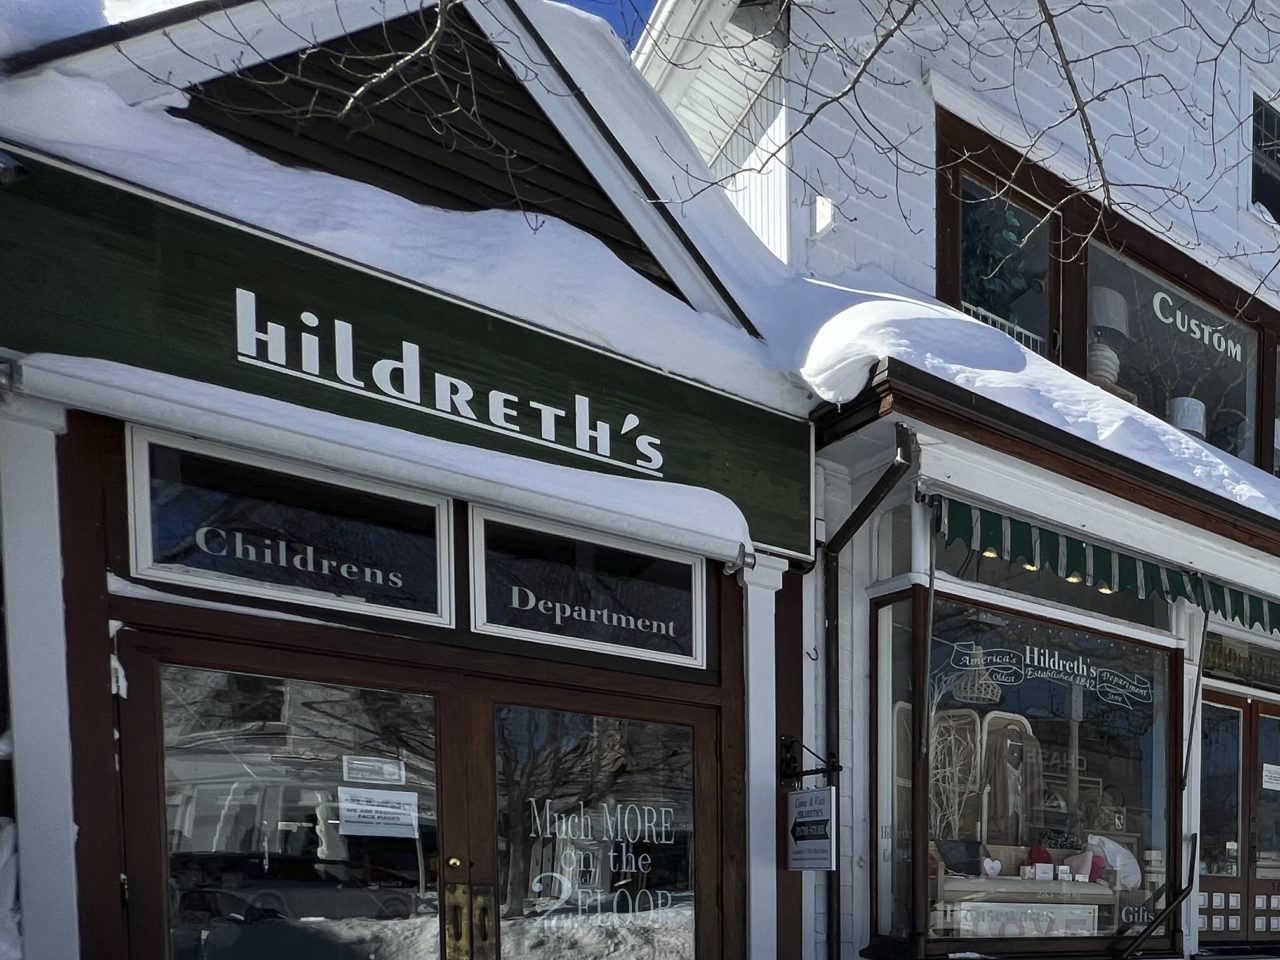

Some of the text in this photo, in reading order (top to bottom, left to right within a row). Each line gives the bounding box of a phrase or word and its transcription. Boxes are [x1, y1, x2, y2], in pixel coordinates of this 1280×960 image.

[195, 527, 677, 638] Childrens Department
[959, 654, 1017, 666] America's
[1024, 645, 1097, 678] Hildreth's
[992, 673, 1016, 683] Oldest
[1025, 667, 1095, 690] Established 1842
[1101, 671, 1147, 696] Department
[528, 798, 675, 844] Much MORE
[561, 843, 652, 873] on the
[575, 888, 674, 927] FLOOR
[1121, 905, 1155, 924] Gifts
